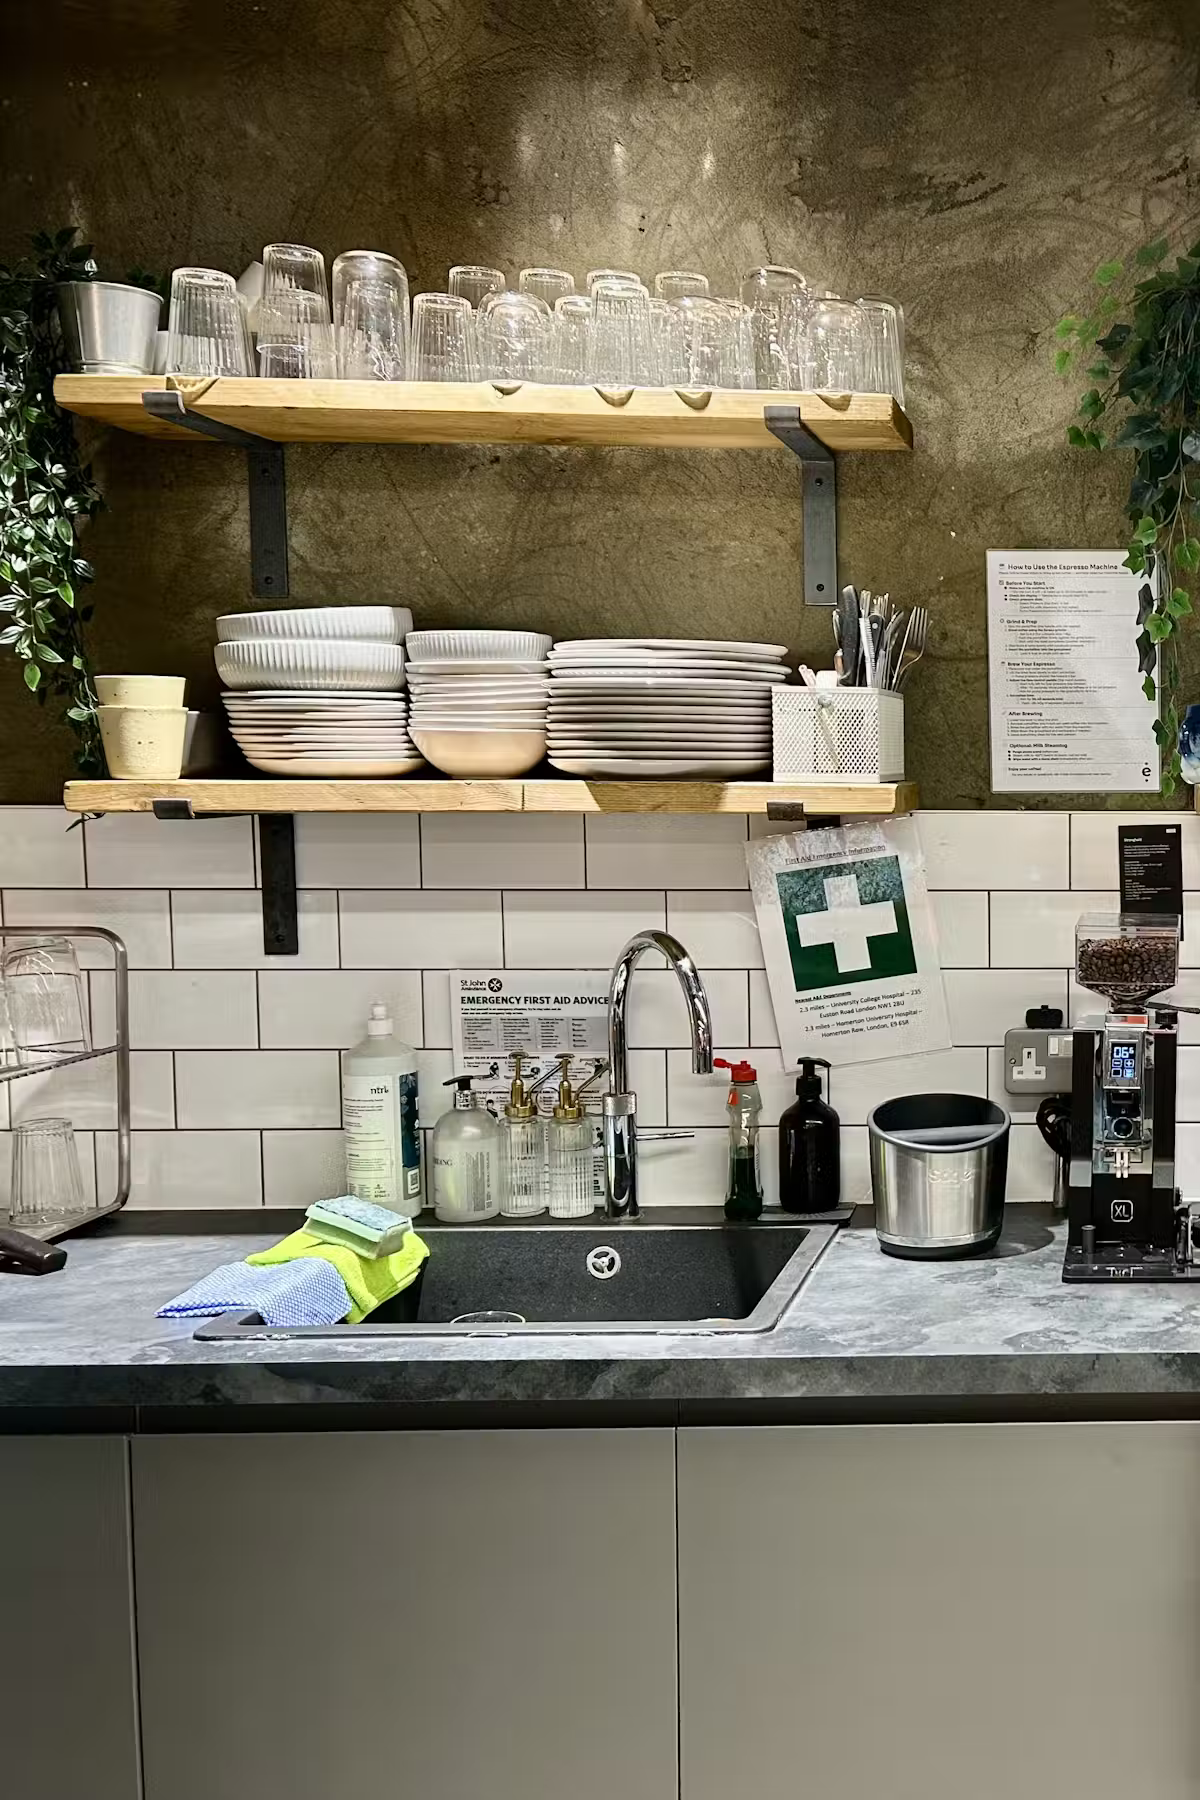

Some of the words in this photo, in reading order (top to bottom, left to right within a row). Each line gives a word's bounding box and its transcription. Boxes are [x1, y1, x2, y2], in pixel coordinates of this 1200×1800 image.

[1059, 564, 1089, 572] Espresso
[812, 850, 847, 861] Emergency
[848, 845, 886, 856] Information
[461, 996, 522, 1005] EMERGENCY
[524, 996, 552, 1005] FIRST
[553, 996, 572, 1005] AID
[573, 996, 610, 1005] ADVICE
[831, 1000, 860, 1008] University
[881, 992, 905, 1000] Hospital
[836, 1019, 865, 1027] Homerton
[822, 1030, 851, 1038] Homerton
[1114, 1205, 1130, 1218] XL
